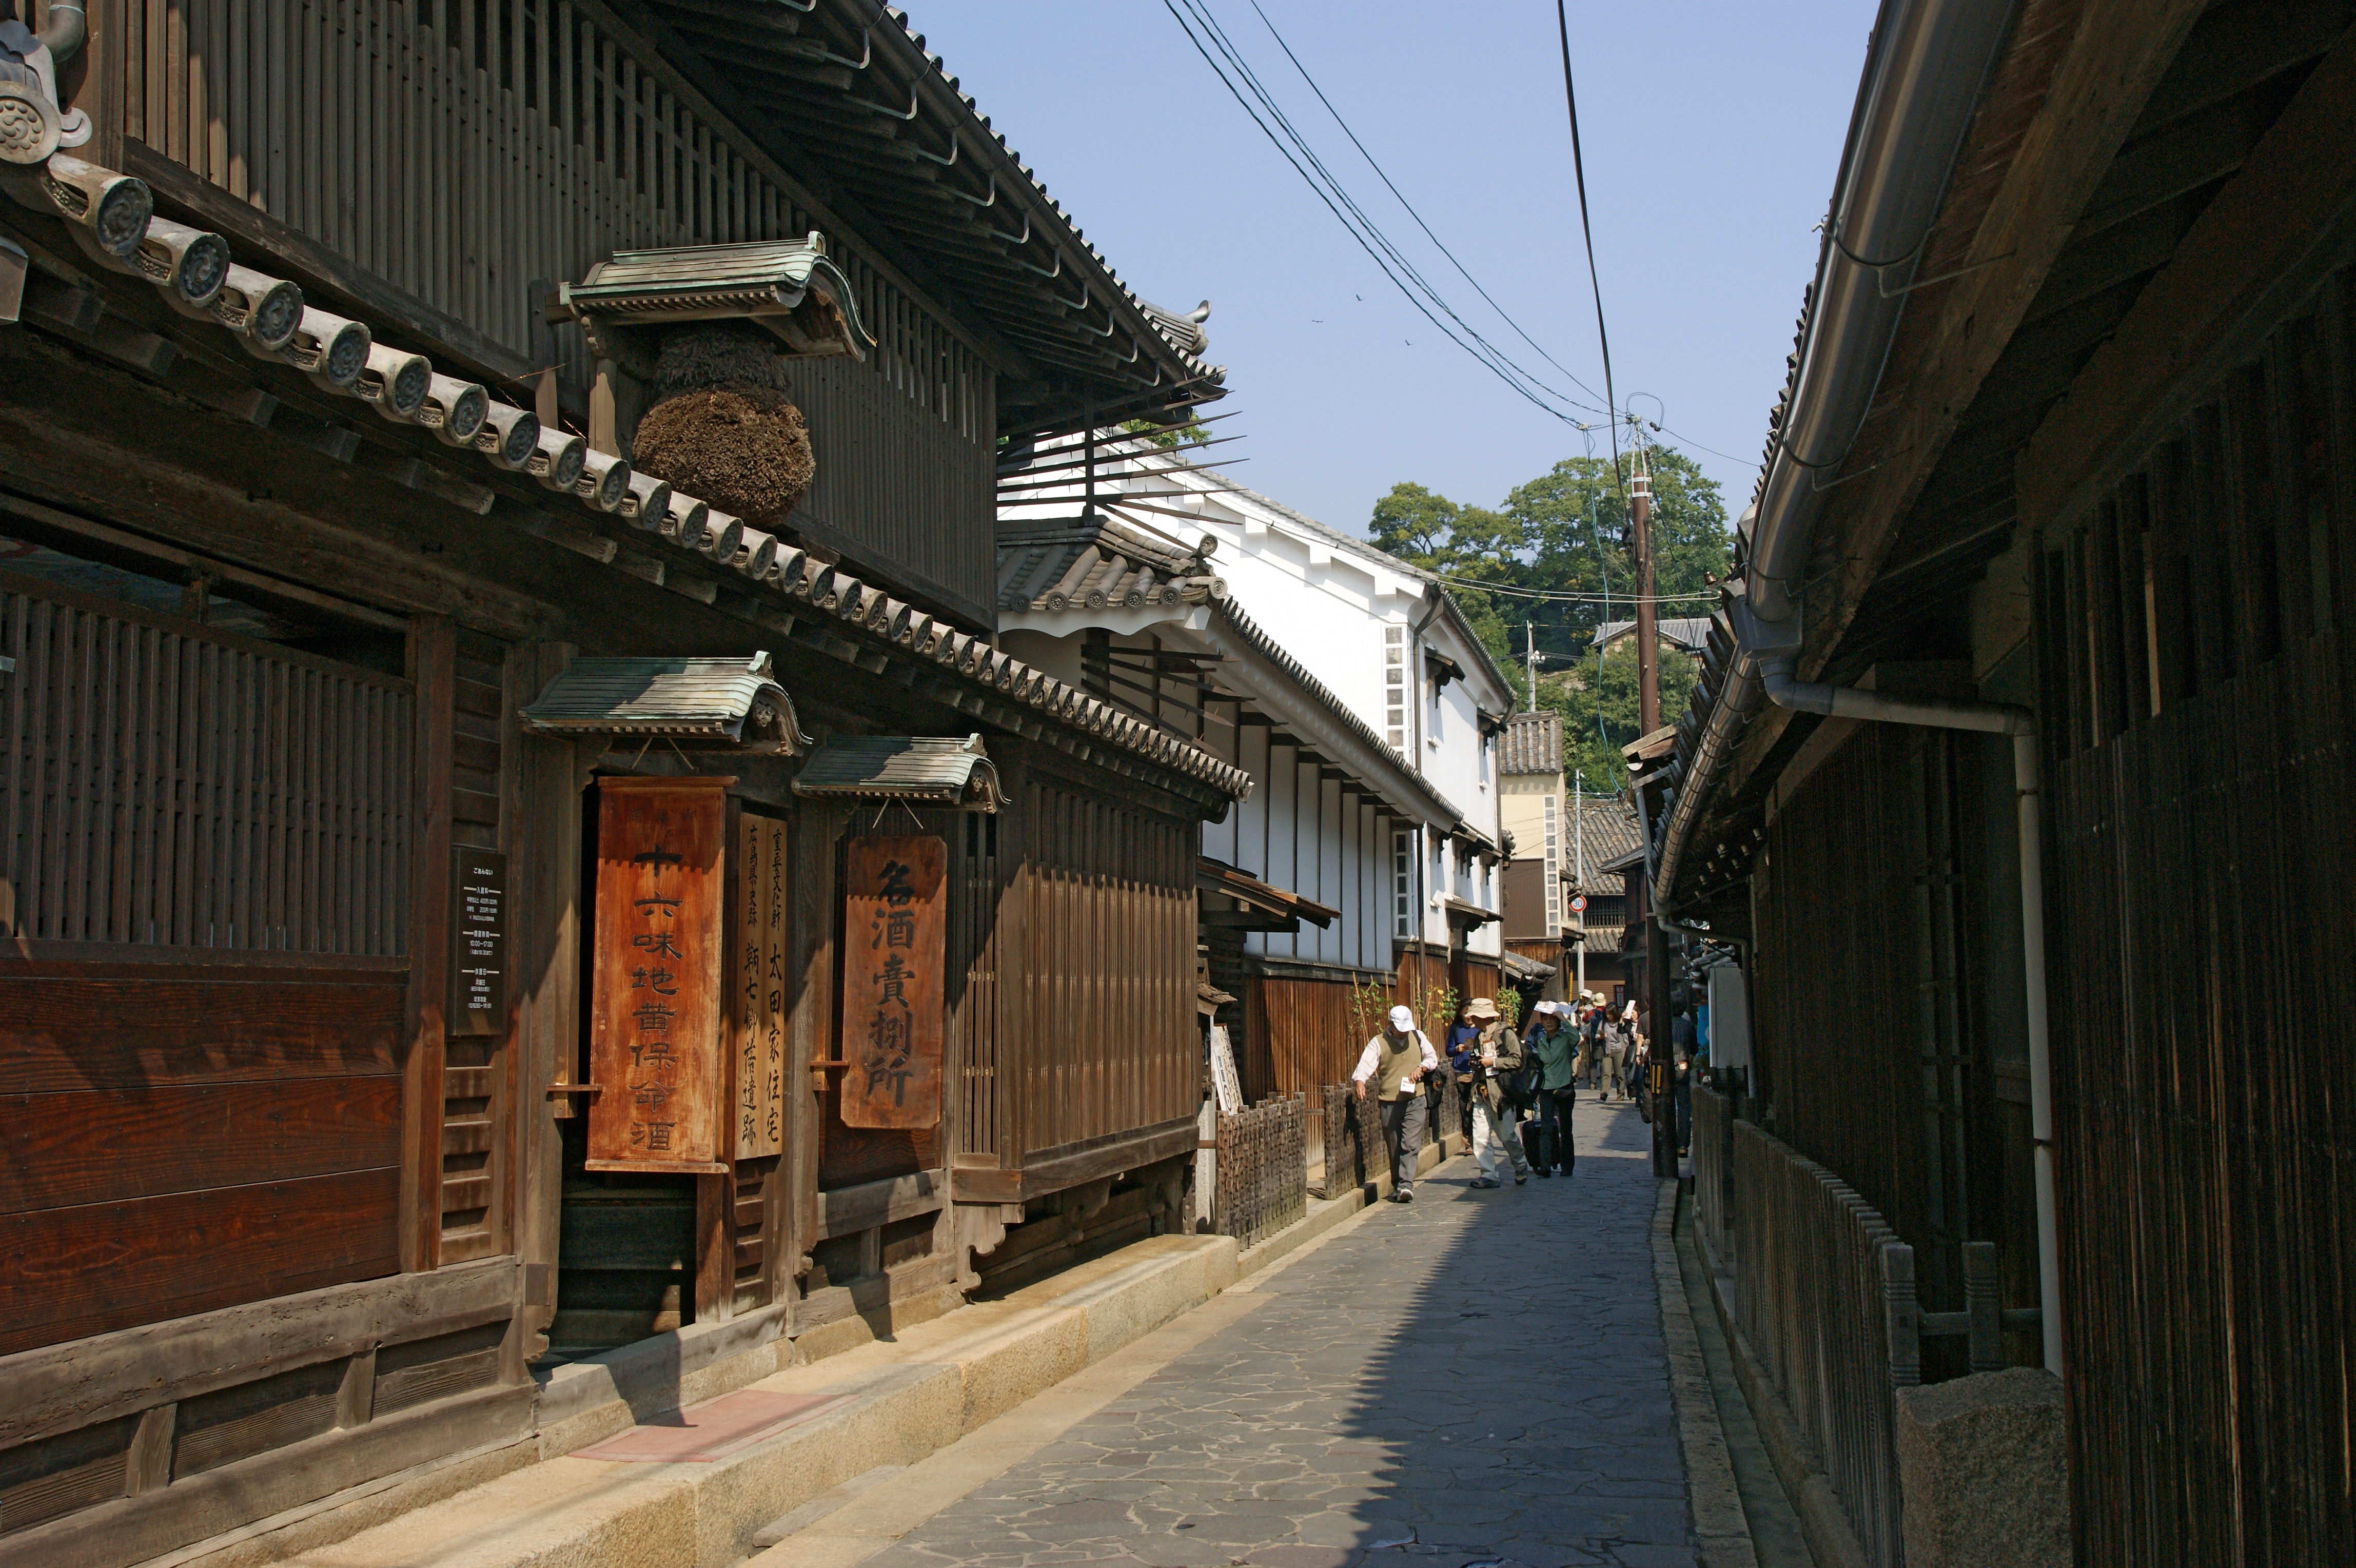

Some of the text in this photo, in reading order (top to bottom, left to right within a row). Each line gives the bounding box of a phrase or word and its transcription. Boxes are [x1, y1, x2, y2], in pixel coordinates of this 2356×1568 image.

[474, 867, 493, 875] ごあんない
[748, 825, 758, 928] 広島県史跡
[767, 828, 782, 1143] 重要文化財 太田家住宅
[865, 860, 915, 1108] 名酒賣捌所
[629, 845, 683, 1151] 十六味地黄保命酒
